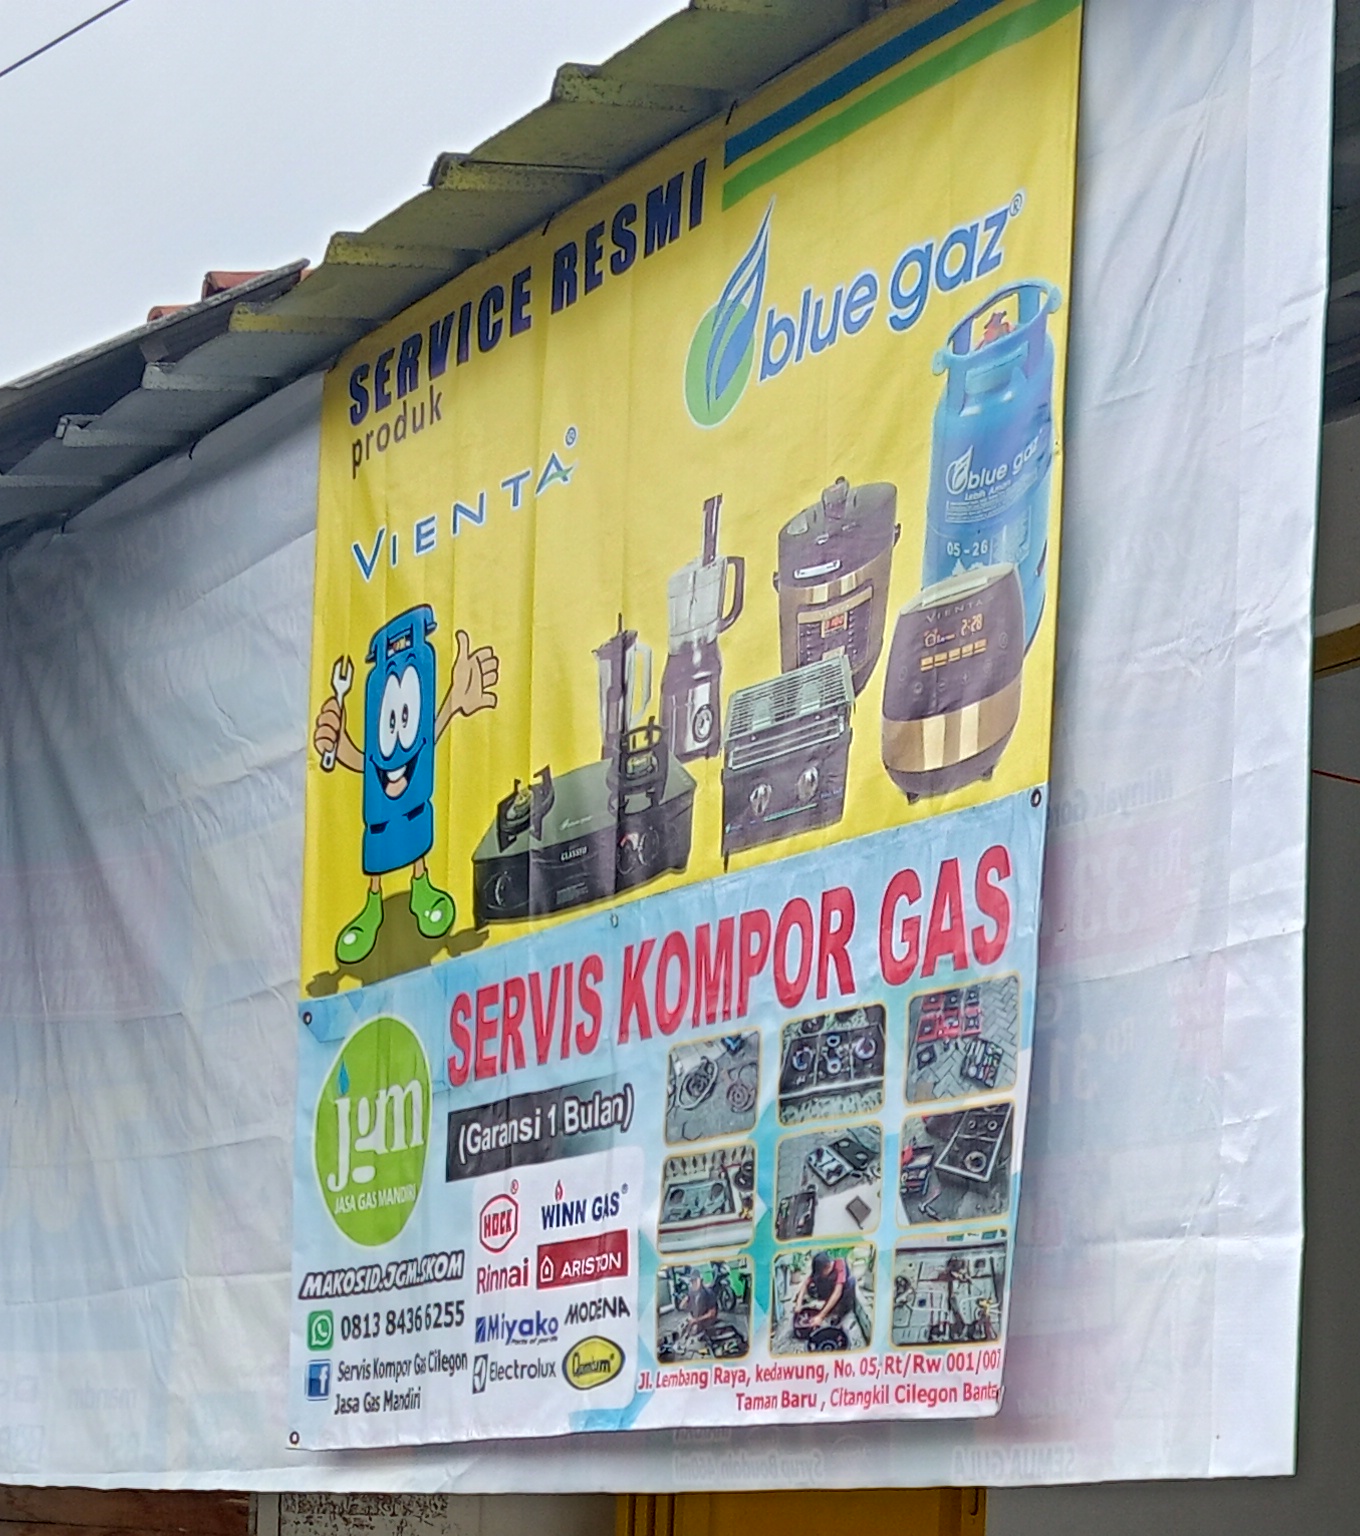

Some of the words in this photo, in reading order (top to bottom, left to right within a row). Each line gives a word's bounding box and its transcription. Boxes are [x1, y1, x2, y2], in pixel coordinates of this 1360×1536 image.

[348, 268, 532, 426] SERVICE
[551, 158, 706, 315] RESMI
[757, 269, 879, 386] blue
[887, 202, 1012, 333] gaz
[350, 391, 443, 479] produk
[968, 463, 1008, 490] blue
[350, 452, 576, 583] VIENTA
[447, 951, 604, 1088] SERVIS
[617, 885, 856, 1046] KOMPOR
[879, 844, 1011, 988] GAS
[458, 1111, 541, 1165] (Garansi
[546, 1104, 557, 1138] 1
[563, 1083, 634, 1134] Bulan)
[334, 1192, 358, 1215] JASA
[358, 1189, 378, 1212] GAS
[591, 1191, 620, 1222] GAS
[483, 1215, 513, 1238] HOCK
[476, 1257, 529, 1294] Rinnai
[561, 1251, 622, 1279] ARISTON
[341, 1311, 381, 1341] 0813
[564, 1296, 630, 1326] MODENA
[487, 1310, 559, 1346] Miyako
[337, 1358, 371, 1383] Servis
[373, 1356, 412, 1383] Kompor
[414, 1352, 427, 1376] Gas
[428, 1348, 468, 1377] Cilegon
[489, 1357, 557, 1382] Electrolux
[656, 1369, 708, 1390] Lembang
[714, 1366, 751, 1387] Raya,
[755, 1361, 829, 1385] kedawung,
[834, 1361, 856, 1378] No.
[884, 1353, 941, 1378] Rt/Rw
[334, 1393, 360, 1415] Jasa
[363, 1392, 381, 1413] Gas
[383, 1386, 421, 1412] Mandiri
[736, 1391, 778, 1412] Taman
[781, 1389, 817, 1409] Baru
[830, 1384, 889, 1410] Citangkil
[894, 1383, 957, 1408] Cilegon
